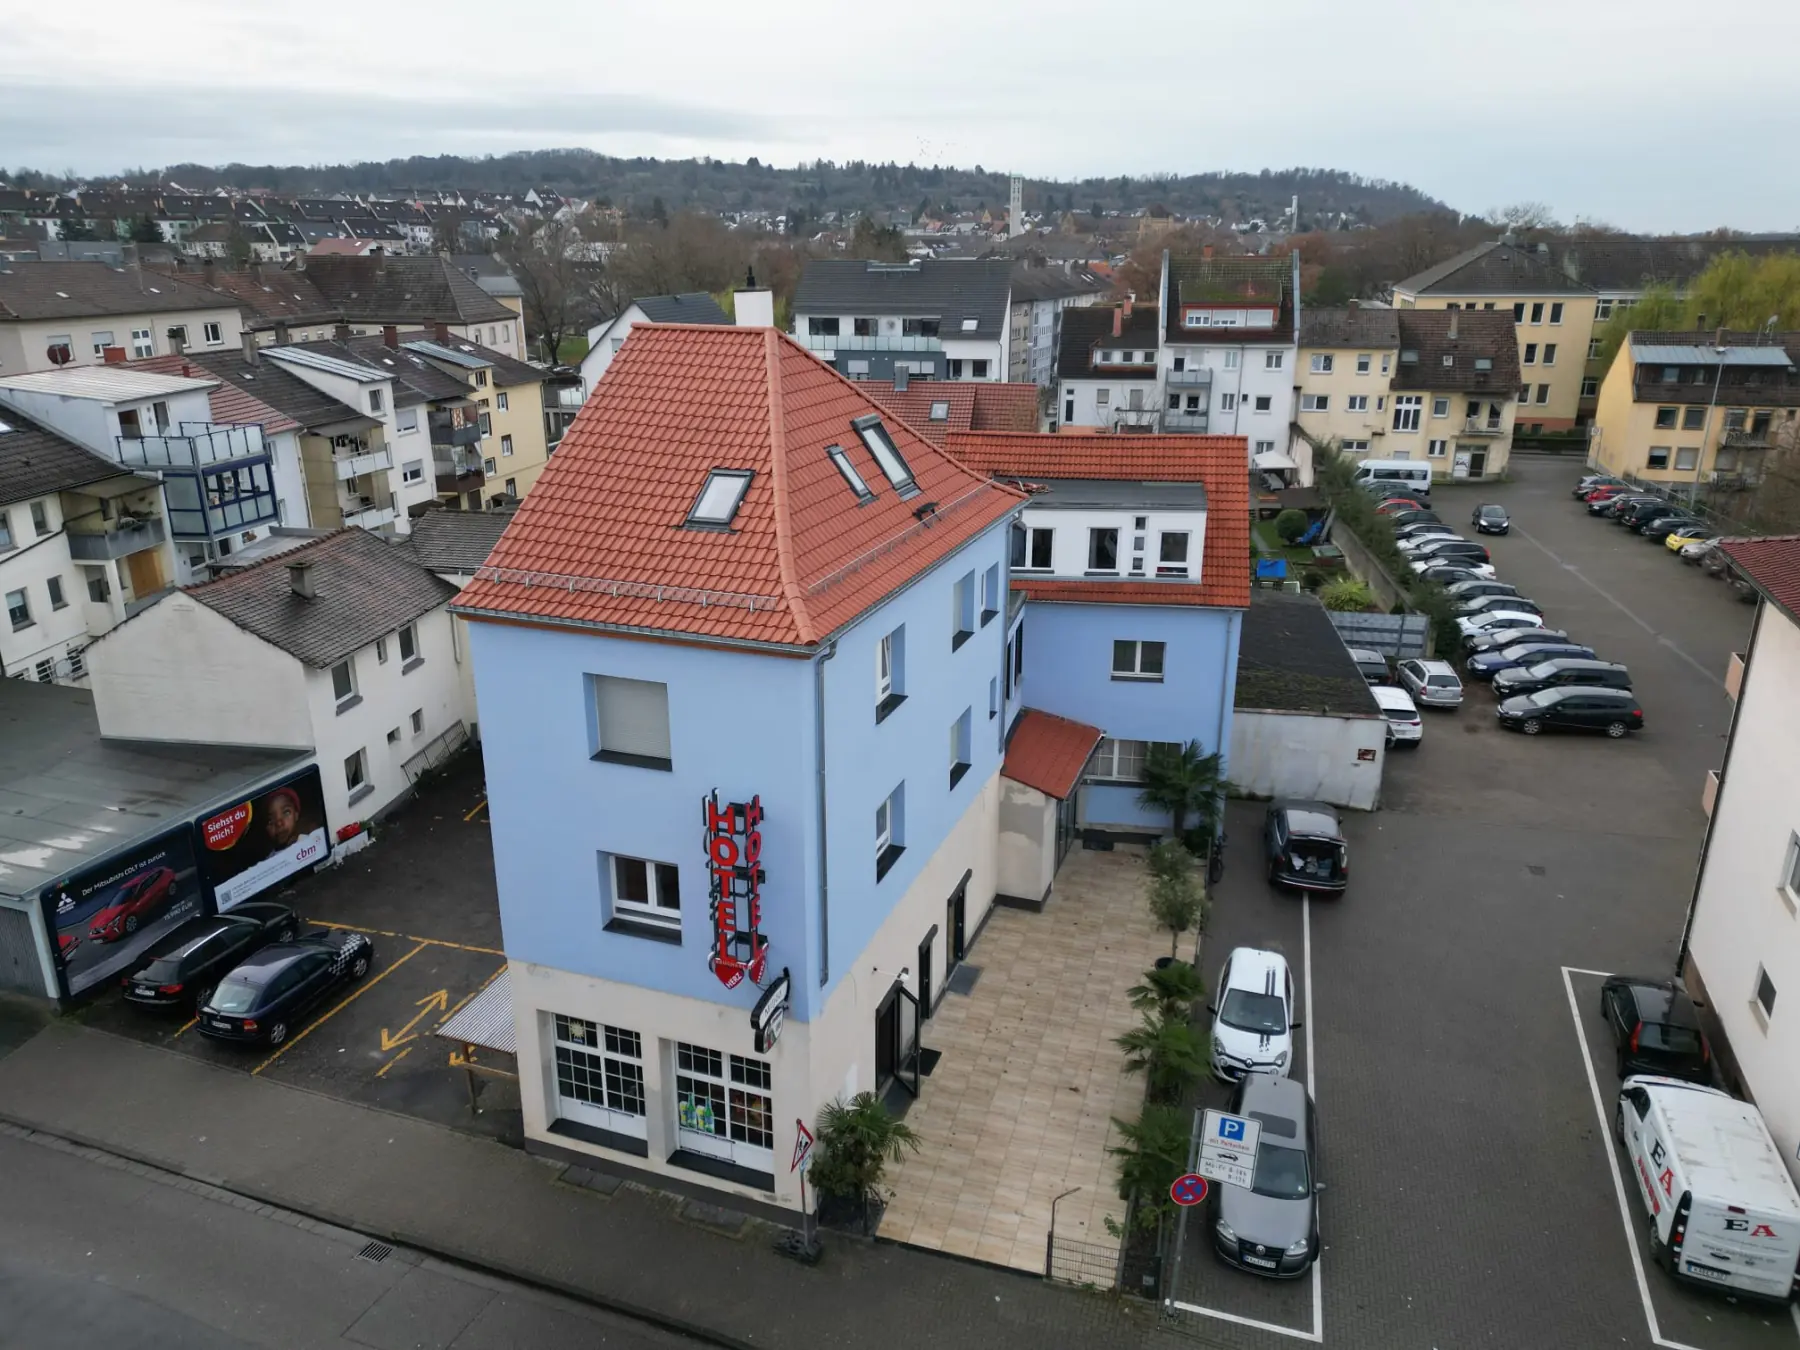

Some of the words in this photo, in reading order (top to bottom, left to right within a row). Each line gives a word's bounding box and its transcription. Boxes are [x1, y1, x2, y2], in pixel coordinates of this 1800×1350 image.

[207, 815, 233, 833] Siehst
[234, 809, 246, 820] du
[210, 825, 234, 843] mich?
[296, 844, 316, 861] cbm
[708, 801, 739, 963] HOTEL
[744, 795, 763, 958] HOTEL
[82, 885, 93, 896] Der
[725, 972, 742, 988] HERZ
[1224, 1120, 1239, 1136] P
[1724, 1219, 1778, 1237] EA
